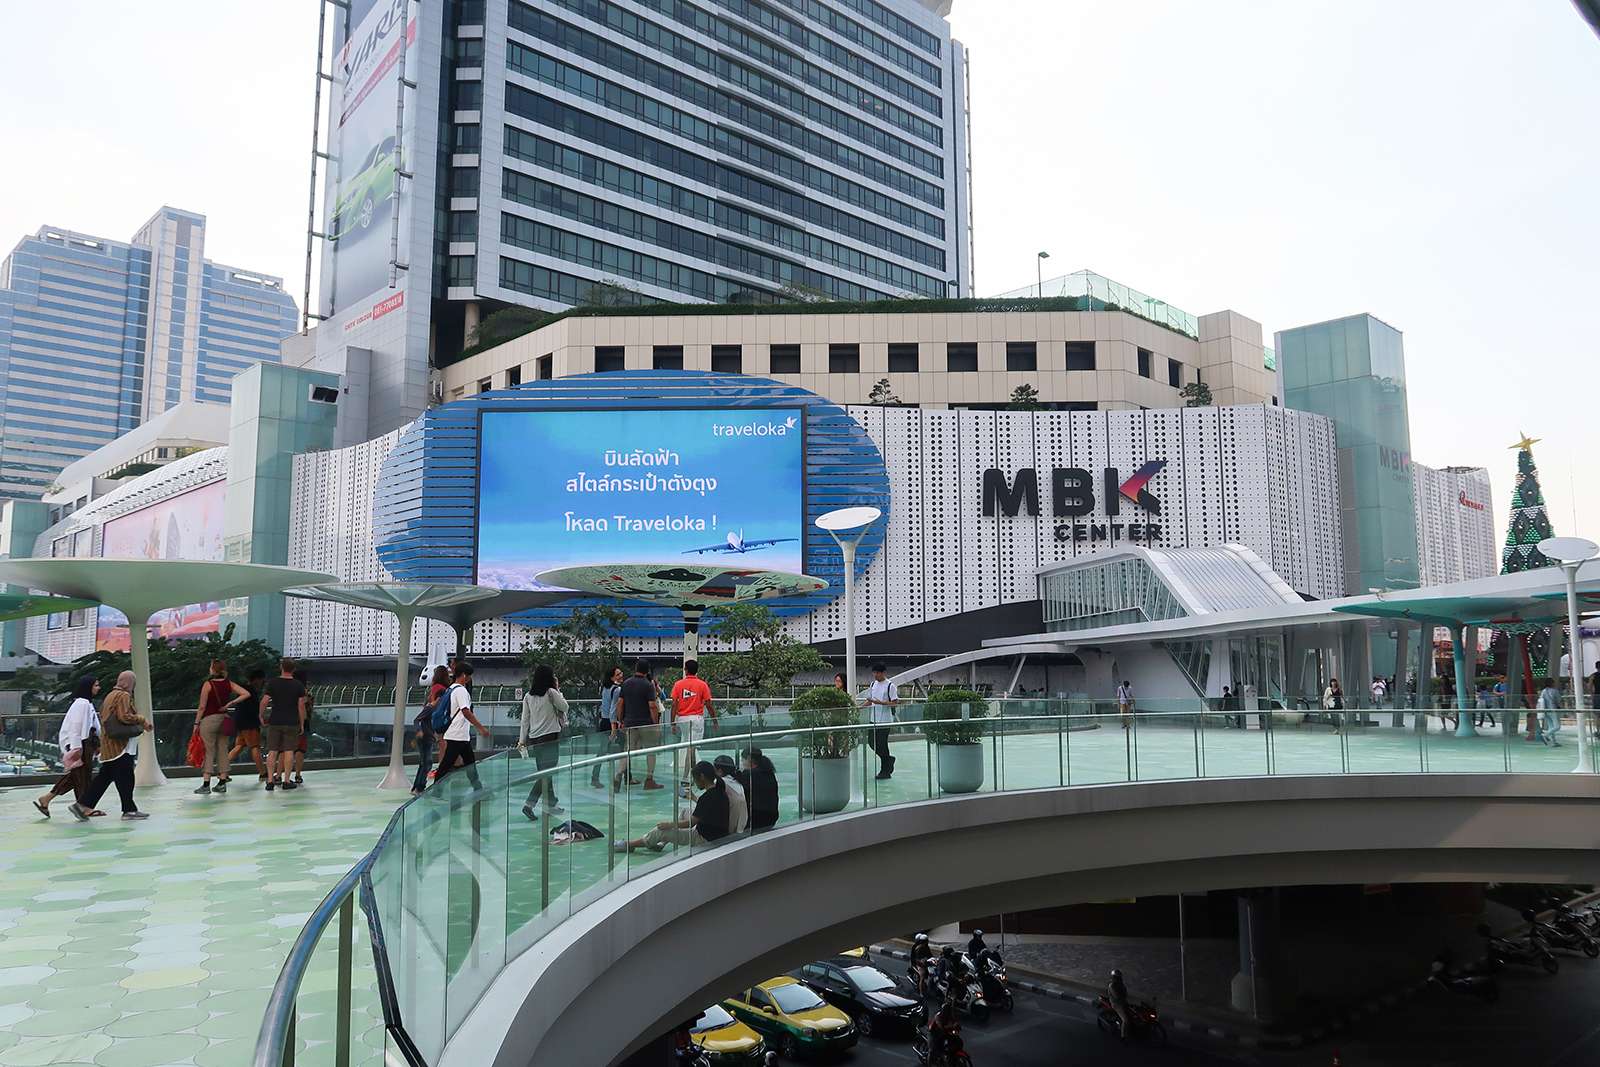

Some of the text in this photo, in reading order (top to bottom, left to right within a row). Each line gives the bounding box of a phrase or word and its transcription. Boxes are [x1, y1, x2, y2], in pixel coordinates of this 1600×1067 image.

[712, 422, 787, 436] traveloka
[604, 448, 680, 467] บินลัดฟ้า
[566, 472, 718, 497] สไตล์กระเป๋าตังตุง
[982, 460, 1170, 517] MBK
[565, 512, 608, 532] โหลด
[614, 515, 706, 532] Traveloka
[1053, 523, 1162, 542] CENTER
